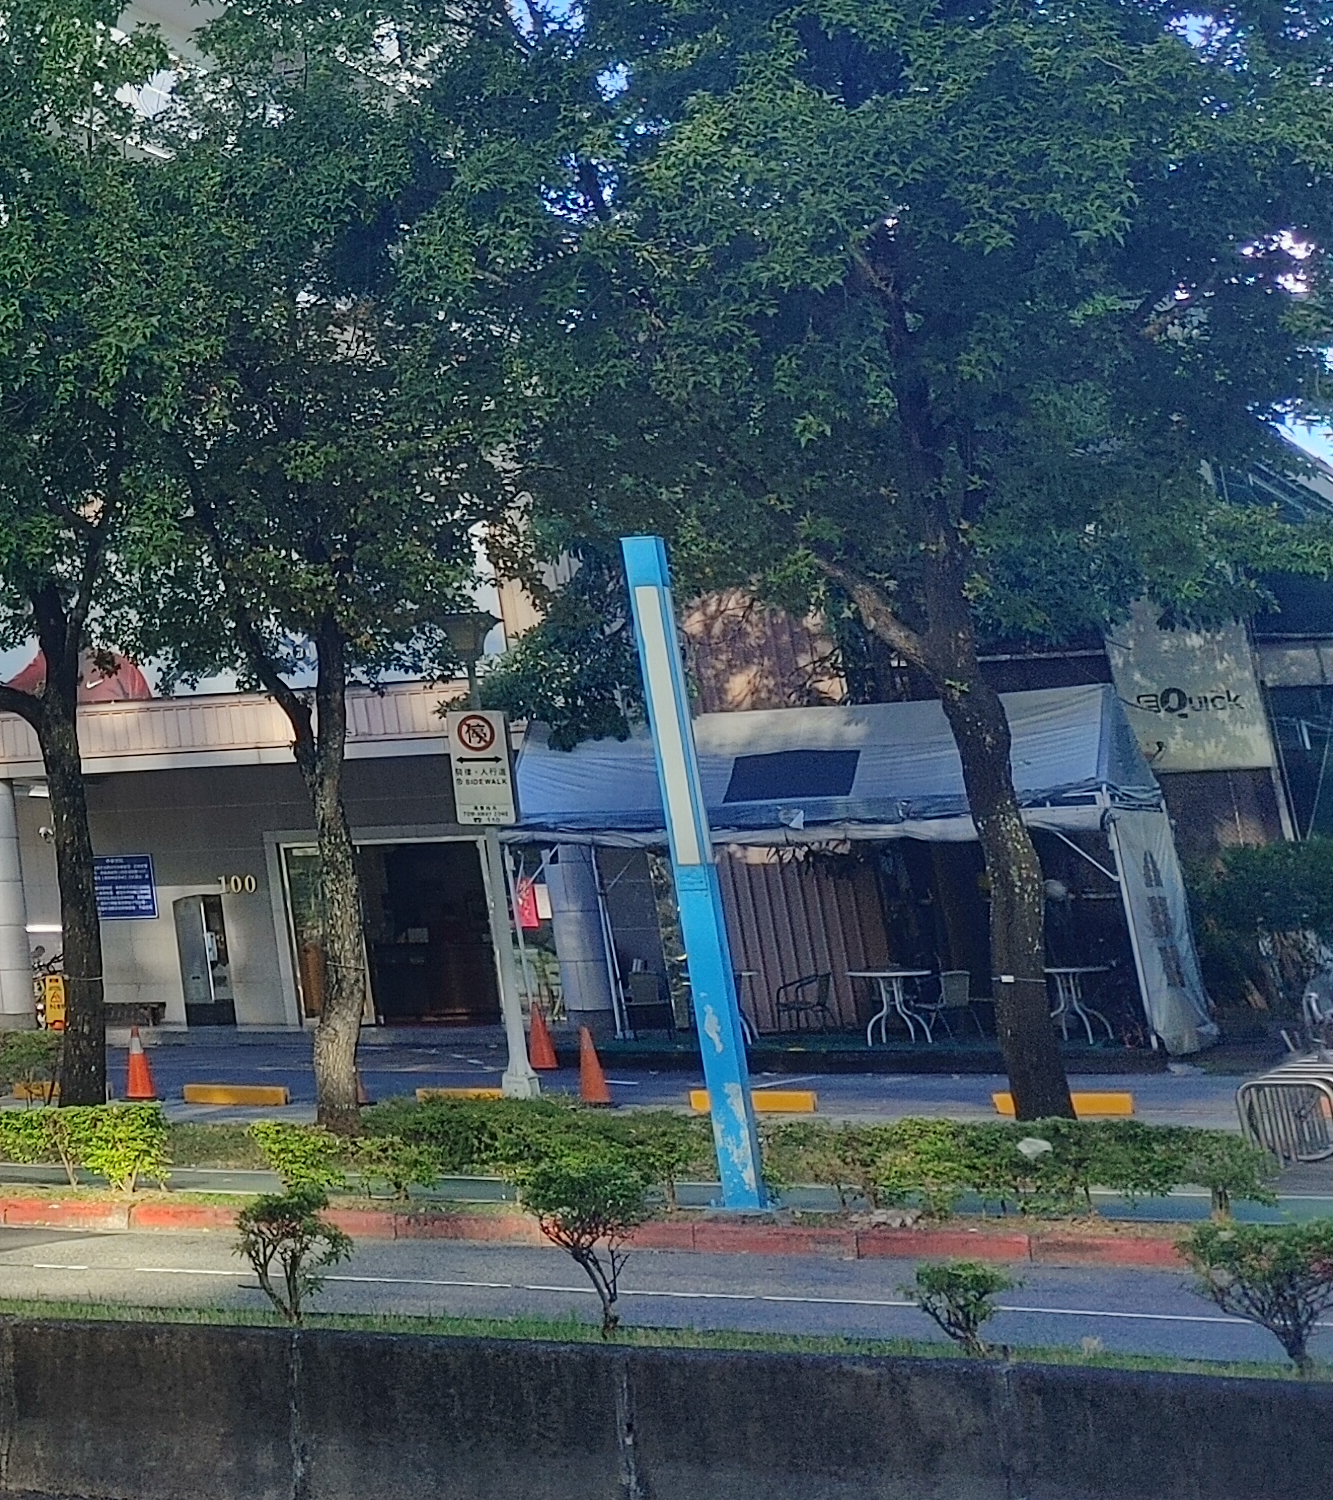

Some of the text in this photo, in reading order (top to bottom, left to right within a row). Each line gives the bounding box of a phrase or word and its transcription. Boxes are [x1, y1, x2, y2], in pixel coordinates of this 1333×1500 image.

[465, 723, 487, 744] 停
[465, 778, 507, 786] SIDEWALK
[218, 874, 256, 894] 100
